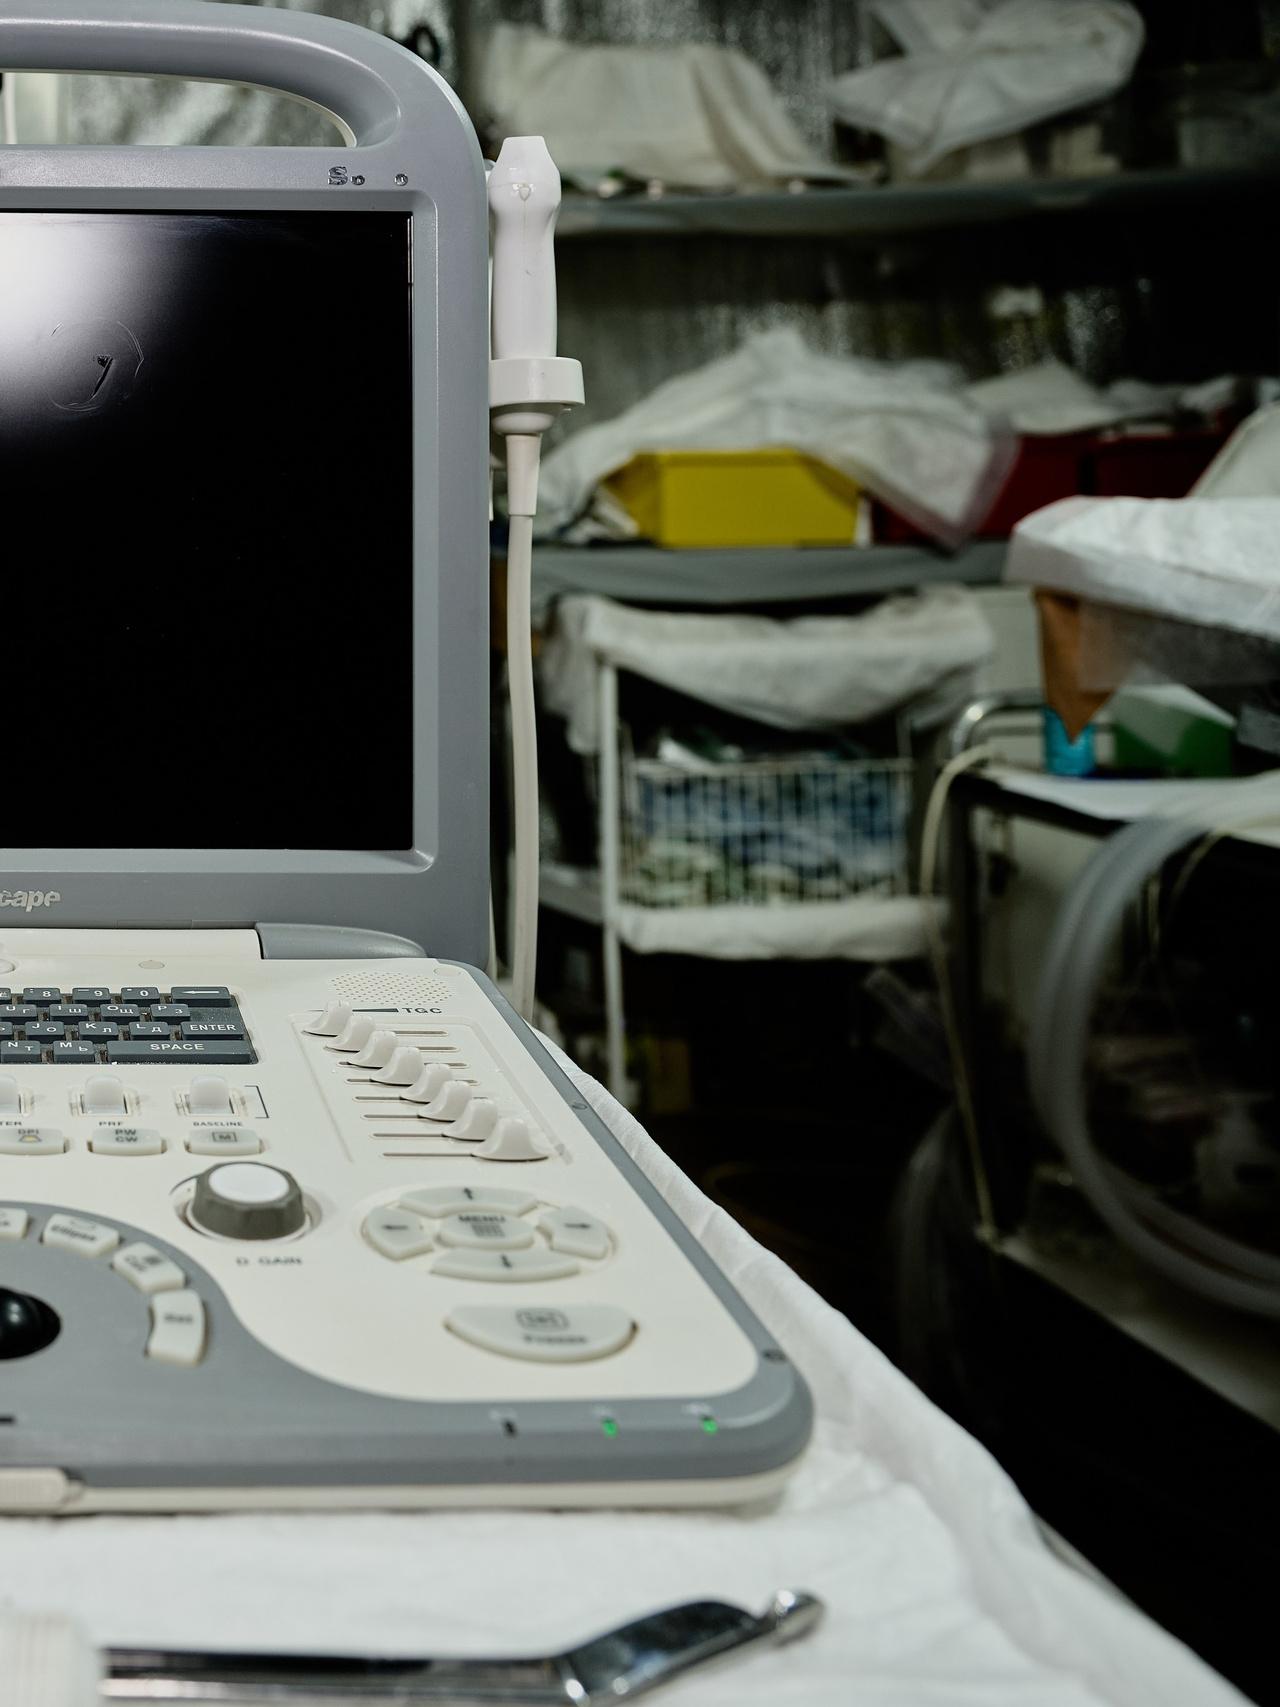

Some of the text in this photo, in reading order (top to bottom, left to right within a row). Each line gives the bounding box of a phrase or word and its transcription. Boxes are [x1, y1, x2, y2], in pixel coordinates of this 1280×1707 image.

[458, 1214, 506, 1223] MENU
[236, 1257, 302, 1266] D GAIN
